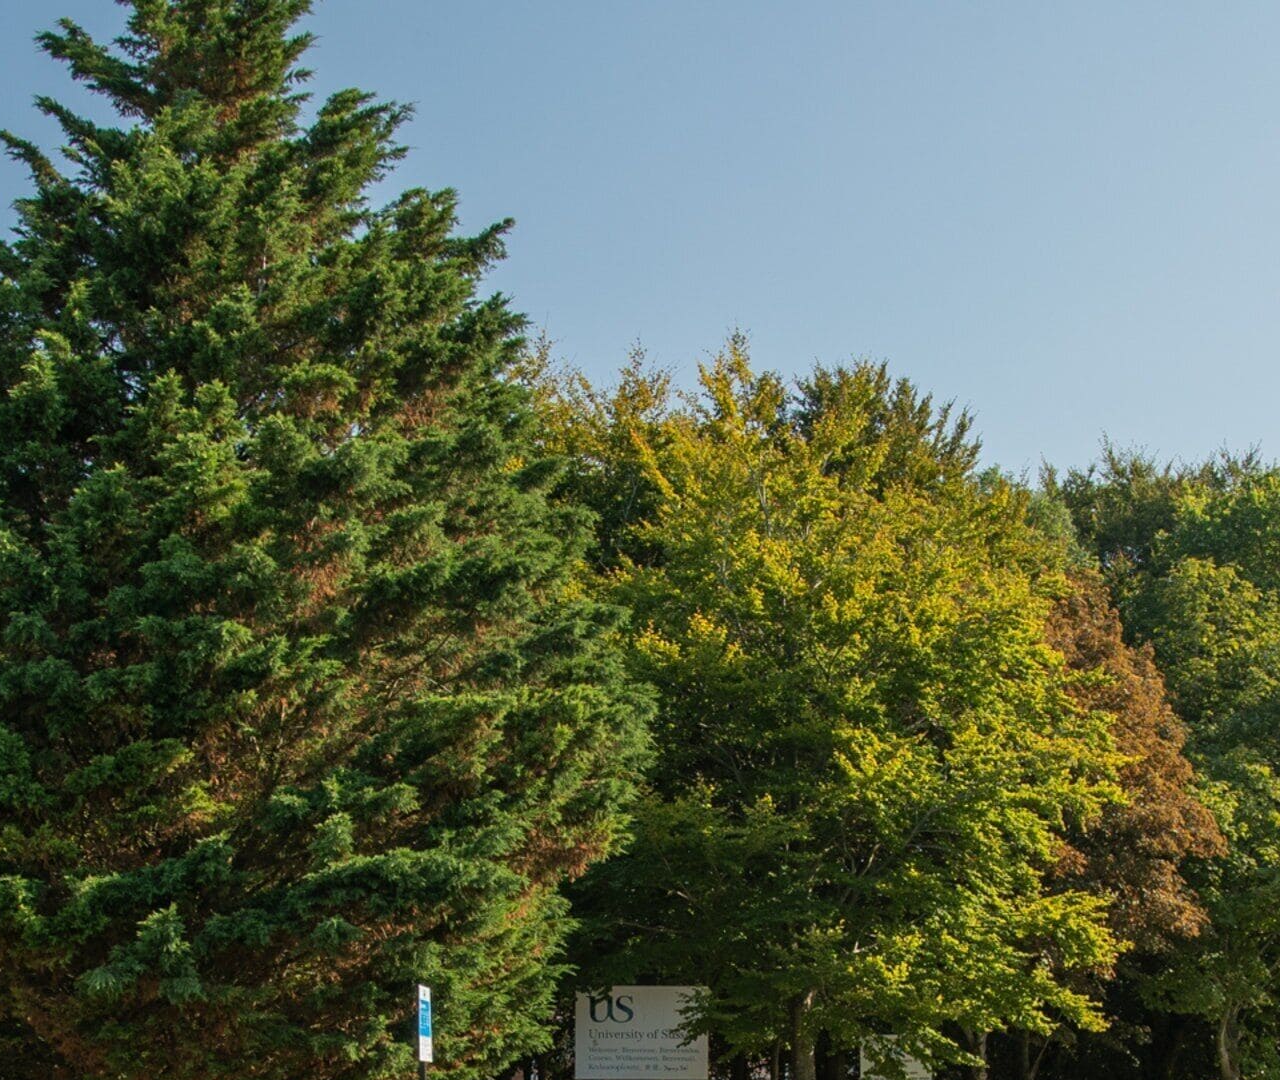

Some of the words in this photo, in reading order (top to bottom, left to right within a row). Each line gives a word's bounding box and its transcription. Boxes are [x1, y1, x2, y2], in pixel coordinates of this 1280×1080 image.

[588, 1029, 645, 1042] University
[646, 1029, 658, 1040] of
[661, 1028, 690, 1040] Suss
